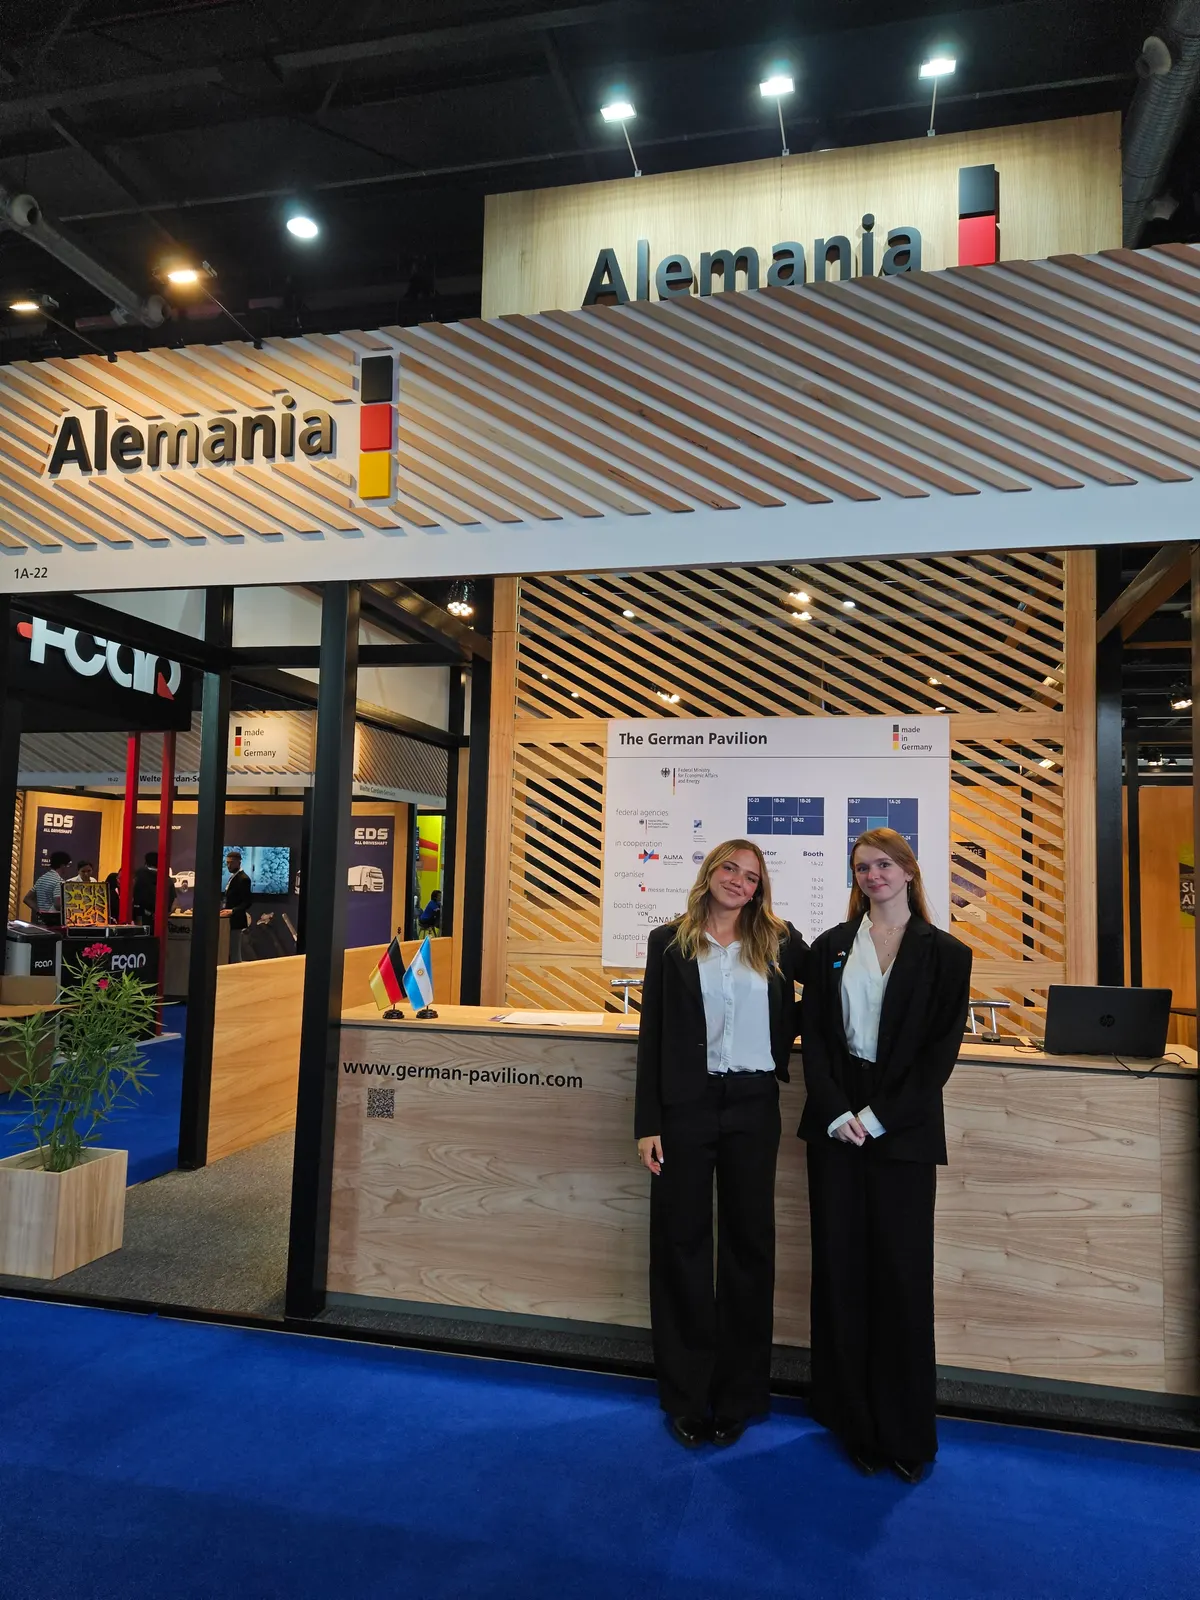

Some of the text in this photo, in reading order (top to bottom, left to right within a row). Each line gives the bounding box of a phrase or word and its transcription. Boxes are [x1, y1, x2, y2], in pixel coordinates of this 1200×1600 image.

[582, 213, 921, 305] Alemania
[48, 395, 333, 475] Alemania
[14, 566, 48, 579] 1A-22
[244, 728, 265, 736] made
[243, 738, 251, 746] in
[619, 732, 768, 746] The German Pavilion
[901, 743, 933, 752] Germany
[243, 749, 277, 758] Germany
[616, 808, 669, 818] federal agencies
[43, 813, 75, 828] EDS
[354, 827, 388, 840] EDS
[622, 840, 662, 850] cooperation
[614, 870, 645, 879] organiser
[613, 901, 657, 911] booth design
[612, 933, 640, 941] adapted
[343, 1061, 583, 1088] www.german-pavilion.com
